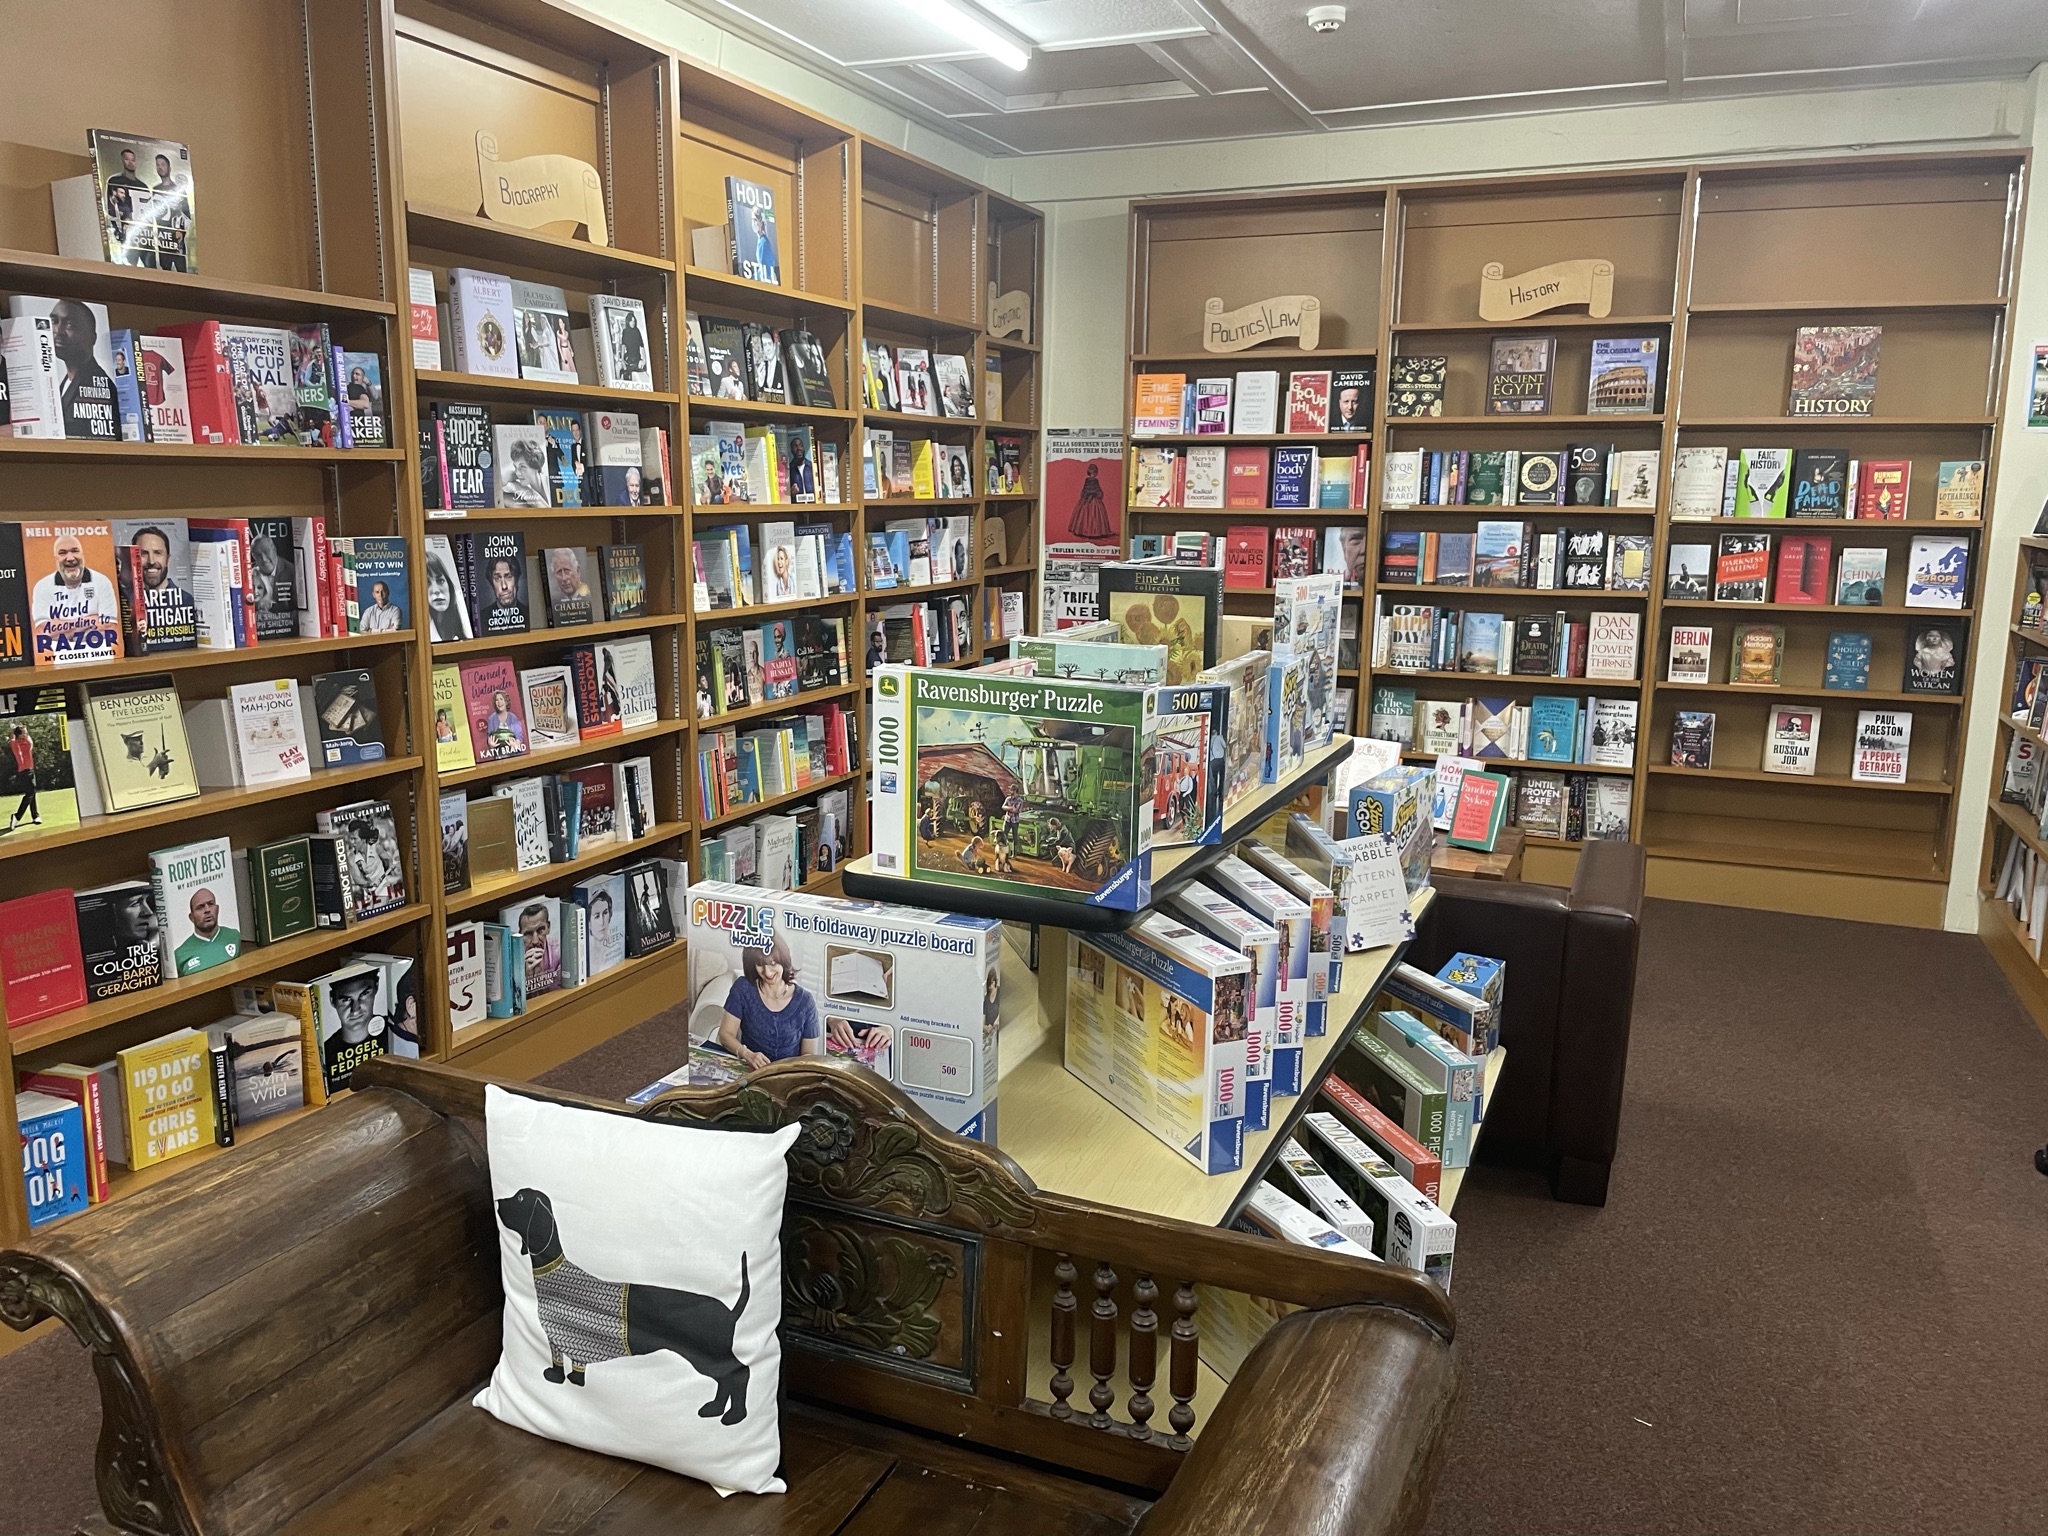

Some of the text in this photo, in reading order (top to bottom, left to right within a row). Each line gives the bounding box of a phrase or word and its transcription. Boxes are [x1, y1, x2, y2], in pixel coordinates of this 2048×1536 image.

[736, 183, 773, 210] HOLD
[743, 260, 779, 285] STILL
[1595, 347, 1640, 355] COLOSSEUM
[254, 356, 285, 370] CUP
[92, 375, 109, 387] FAST
[1333, 379, 1370, 388] CAMERON
[1340, 374, 1363, 382] DAVID
[1493, 375, 1544, 384] ANCIENT
[79, 385, 111, 400] FORWARD
[1493, 383, 1544, 396] EGYPT
[73, 402, 113, 420] ANDREW
[1795, 399, 1873, 414] HISTORY
[158, 407, 187, 426] DEAL
[90, 420, 116, 436] COLE
[450, 418, 483, 446] HOPE
[457, 447, 477, 467] NOT
[625, 447, 640, 456] David
[729, 454, 739, 462] the
[1277, 451, 1310, 464] Every
[1757, 450, 1776, 460] FAKE
[1147, 467, 1163, 475] How
[1277, 462, 1306, 477] body
[1750, 459, 1781, 470] HISTORY
[453, 468, 484, 494] FEAR
[1144, 474, 1164, 482] Britain
[1276, 484, 1299, 493] Olivia
[1387, 485, 1412, 494] MARY
[1276, 492, 1299, 503] Laing
[1386, 492, 1413, 500] BEARD
[1794, 494, 1840, 510] FAMOUS
[25, 527, 52, 537] NEIL
[54, 526, 109, 536] RUDDOCK
[773, 529, 790, 537] SARAH
[798, 527, 829, 535] OPERATION
[364, 542, 389, 550] CLIVE
[487, 535, 514, 546] JOHN
[769, 537, 793, 545] HARDING
[484, 546, 518, 558] BISHOP
[612, 549, 637, 557] PATRICK
[1135, 573, 1181, 586] Fine Art
[1843, 570, 1883, 580] CHINA
[54, 592, 69, 602] The
[50, 600, 89, 619] World
[492, 607, 520, 618] HOW TO
[554, 601, 590, 612] CHARLES
[43, 613, 110, 634] According to
[488, 615, 525, 626] GROW OLD
[1598, 616, 1631, 628] DAN
[157, 625, 196, 637] IS POSSIBLE
[1593, 628, 1634, 641] JONES
[37, 629, 118, 653] RAZOR
[1674, 631, 1709, 646] BERLIN
[45, 650, 116, 662] MY CLOSEST SHAVES
[1390, 660, 1430, 668] CALLIL
[1911, 668, 1955, 679] WOMEN
[584, 651, 600, 722] SHADOW
[1912, 681, 1951, 690] VATICAN
[240, 691, 292, 704] PLAY AND WIN
[917, 678, 1105, 715] Ravensburger Puzzle
[1379, 688, 1395, 699] On
[100, 692, 171, 711] BEN HOGAN'S
[241, 698, 294, 713] MAH-JONG
[534, 697, 561, 707] SAND
[1171, 692, 1199, 711] 500
[112, 704, 165, 718] FIVE LESSONS
[1374, 702, 1404, 716] Cusp
[1595, 710, 1633, 718] Georgians
[1875, 714, 1897, 726] PAUL
[1865, 725, 1903, 737] PRESTON
[879, 716, 900, 767] 1000
[278, 745, 300, 761] PLAY
[480, 743, 527, 759] KATY BRAND
[1773, 744, 1810, 756] RUSSIAN
[1862, 751, 1901, 762] A PEOPLE
[1781, 755, 1798, 765] JOB
[1859, 761, 1902, 773] BETRAYED
[1461, 782, 1498, 797] Pandora
[1527, 780, 1555, 789] UNTIL
[1521, 788, 1560, 798] PROVEN
[1463, 793, 1490, 807] Sykes
[1528, 796, 1552, 806] SAFE
[168, 850, 226, 883] RORY BEST
[1094, 867, 1135, 904] Ravensburger
[693, 898, 775, 936] PUZZLE
[784, 912, 975, 955] The foldaway puzzle board
[731, 932, 774, 953] Handy
[126, 941, 157, 958] TRUE
[93, 953, 159, 976] COLOURS
[123, 964, 159, 980] BARRY
[96, 974, 160, 997] GERAGHTY
[1278, 1000, 1293, 1035] 1000
[909, 1035, 932, 1050] 1000
[1247, 1029, 1261, 1065] 1000
[337, 1039, 379, 1062] ROGER
[134, 1053, 201, 1089] 119 DAYS
[941, 1064, 957, 1076] 500
[1293, 1050, 1302, 1092] Ravensburger
[249, 1071, 290, 1091] Swim
[1220, 1066, 1235, 1103] 1000
[146, 1075, 194, 1104] TO GO
[252, 1085, 287, 1104] Wild
[148, 1107, 196, 1137] CHRIS
[1448, 1110, 1456, 1142] PENGUIN
[147, 1126, 199, 1158] EVANS
[1234, 1119, 1243, 1167] Ravensburger
